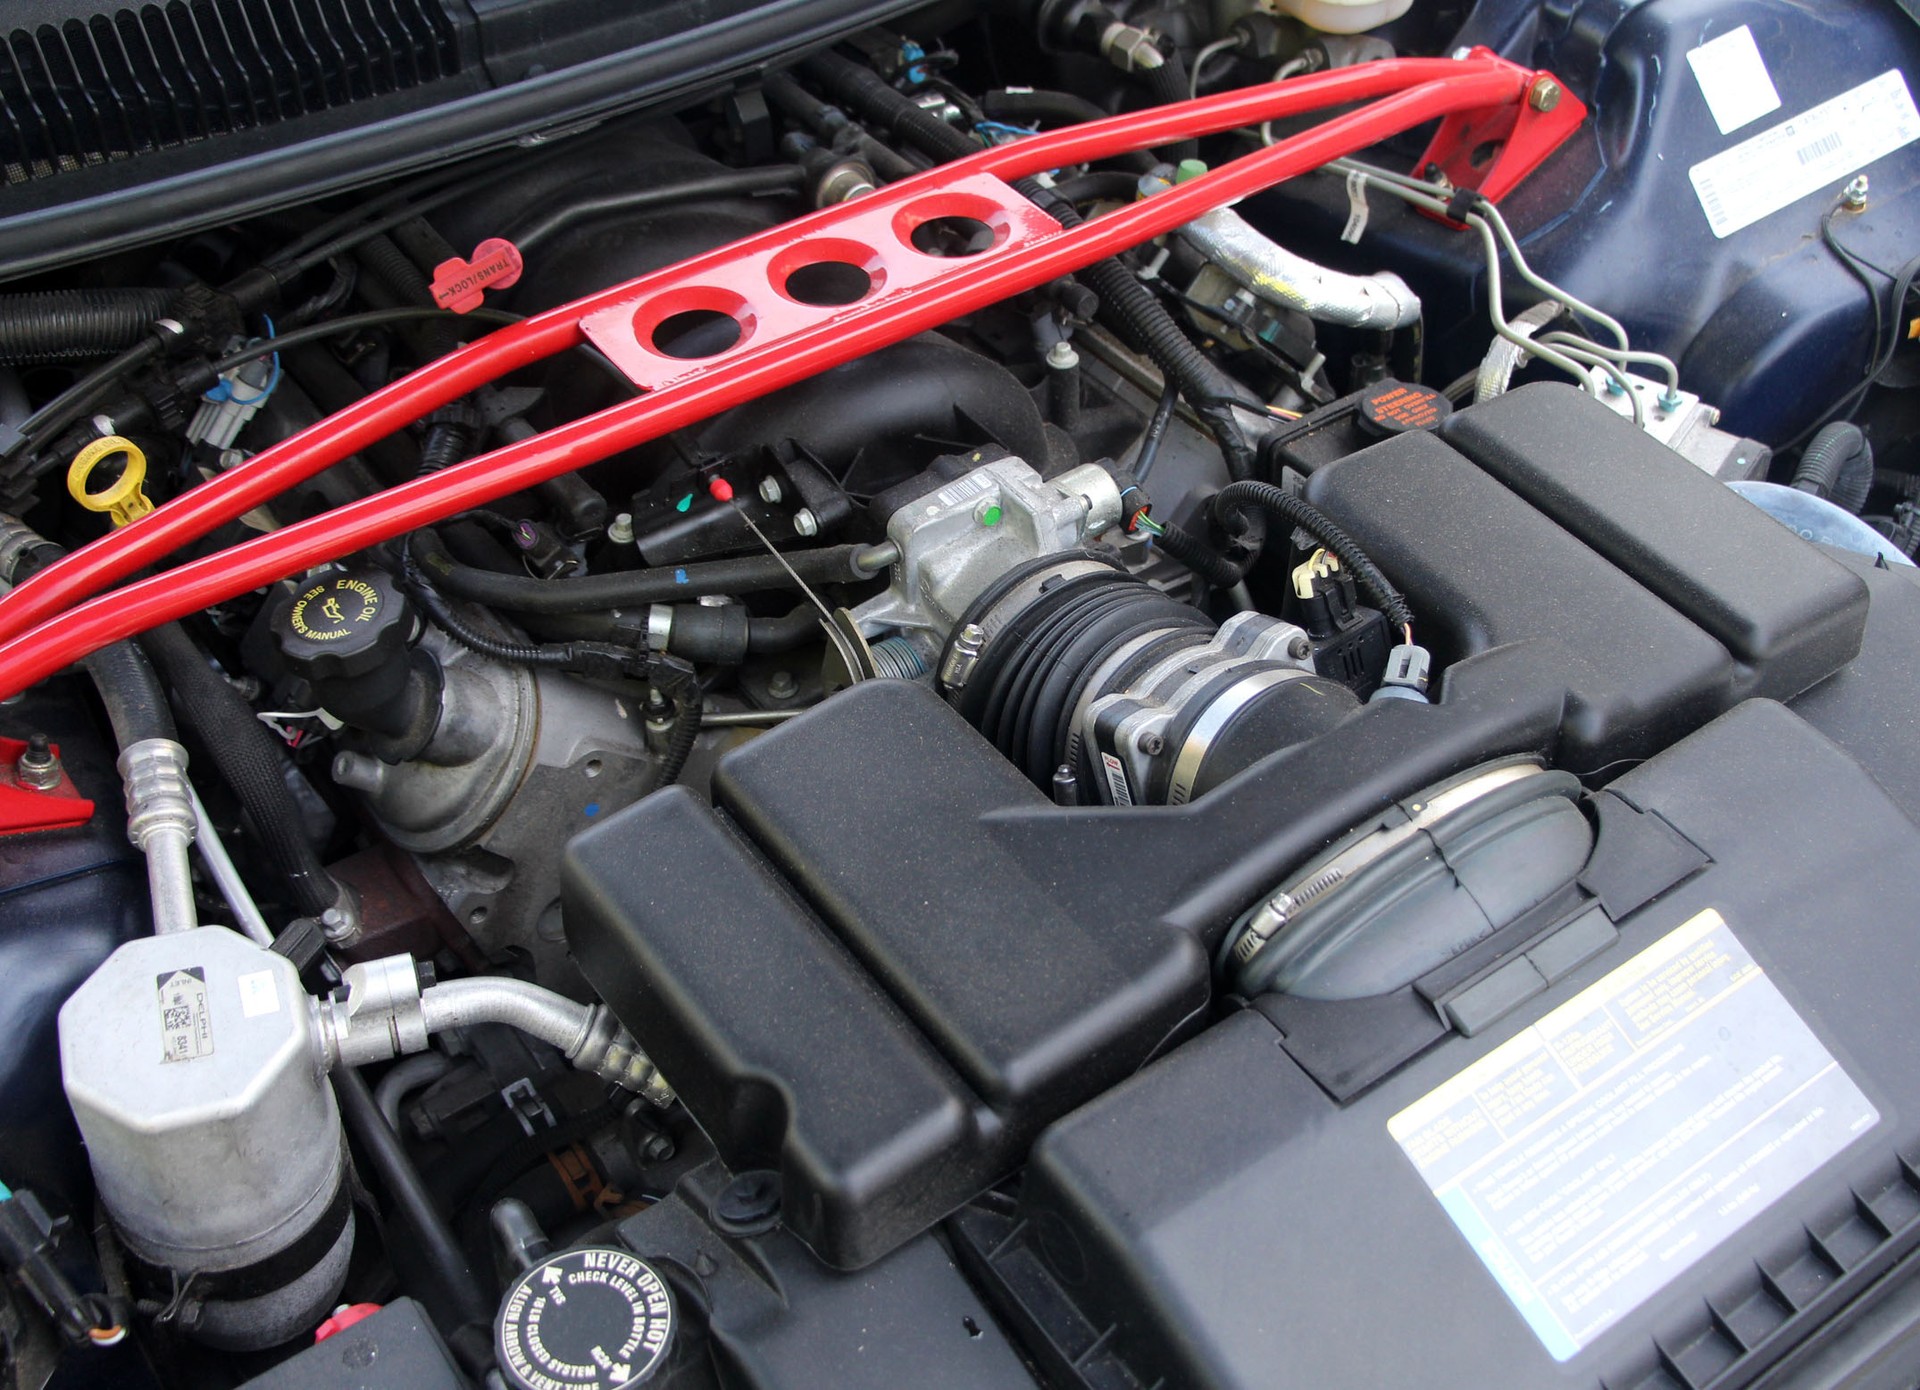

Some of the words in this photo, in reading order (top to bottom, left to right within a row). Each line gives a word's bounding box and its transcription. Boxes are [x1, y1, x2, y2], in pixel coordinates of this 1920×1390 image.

[448, 259, 509, 297] TRANS/LOCK
[1371, 388, 1407, 405] POWER
[1375, 392, 1422, 413] STEERING
[303, 585, 325, 601] SEE
[336, 580, 378, 605] ENGINE
[355, 606, 376, 622] OIL
[305, 628, 351, 640] MANUAL
[197, 992, 208, 1039] DELPHI
[568, 1270, 609, 1285] CHECK
[584, 1253, 640, 1278] NEVER
[549, 1285, 566, 1305] TVS
[609, 1274, 639, 1302] LEVEL
[637, 1272, 667, 1314] OPEN
[507, 1284, 532, 1323] ALIGN
[631, 1300, 645, 1315] IN
[505, 1323, 528, 1367] ARROW
[619, 1316, 646, 1359] BOTTLE
[643, 1317, 667, 1354] HOT
[527, 1324, 550, 1363] CLOSED
[549, 1358, 596, 1378] SYSTEM
[519, 1363, 532, 1376] &
